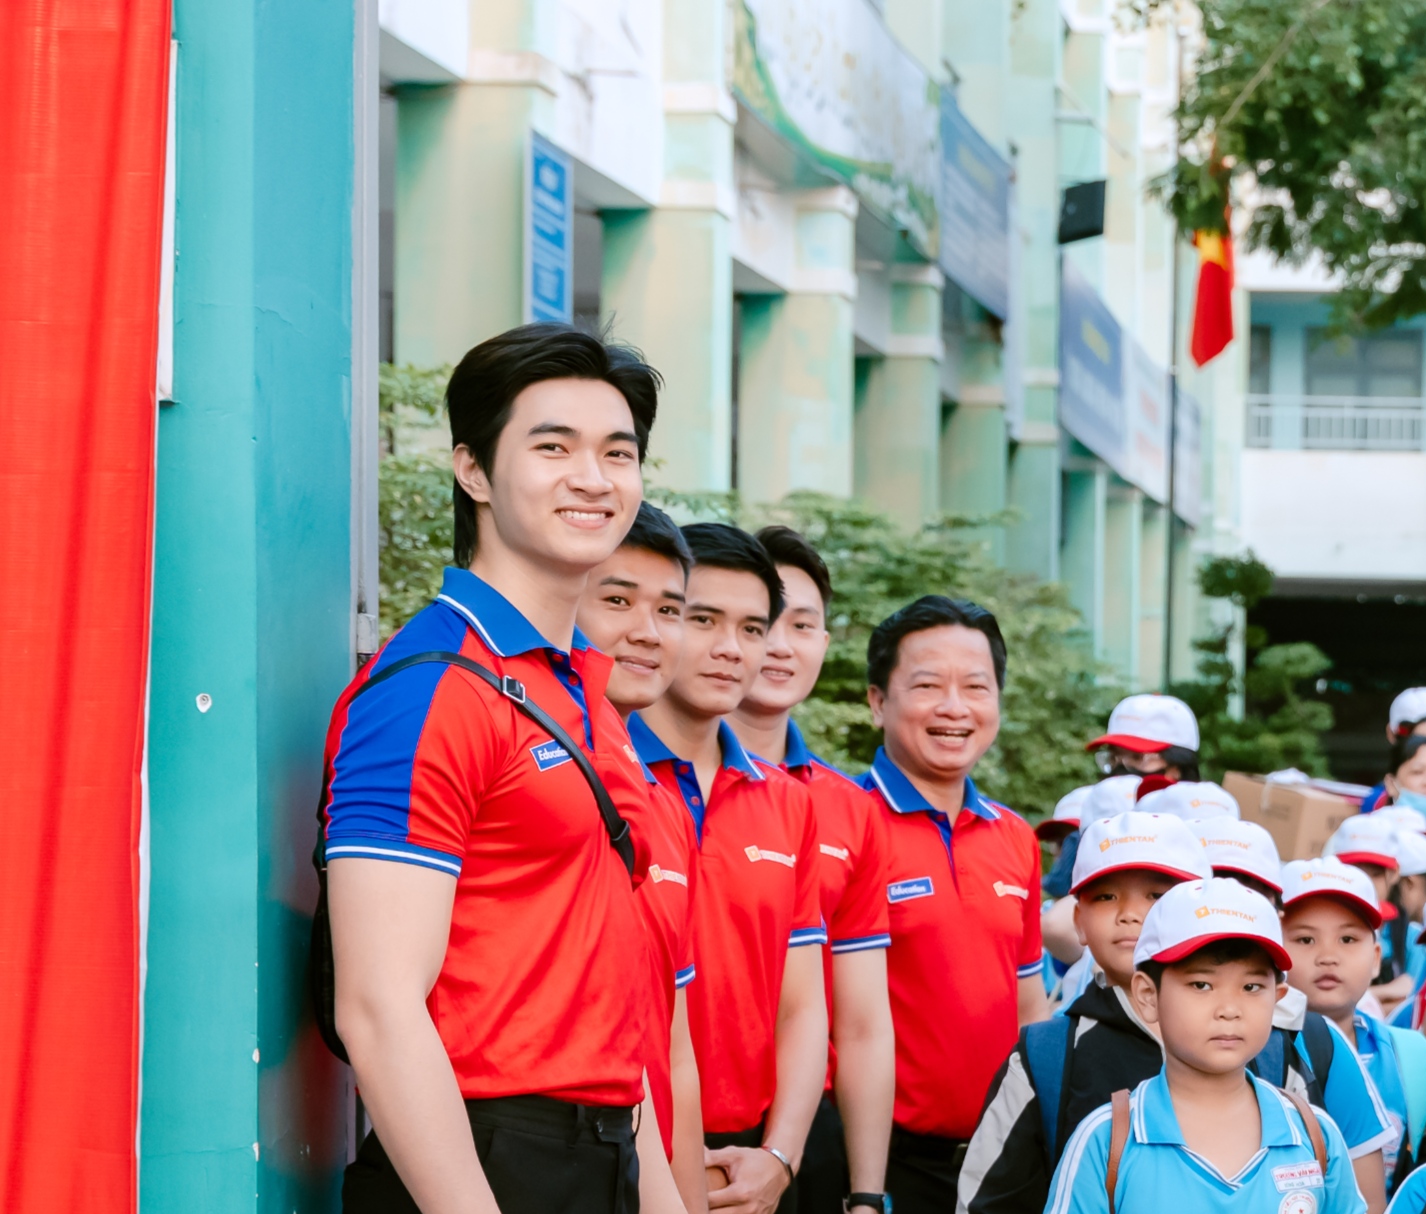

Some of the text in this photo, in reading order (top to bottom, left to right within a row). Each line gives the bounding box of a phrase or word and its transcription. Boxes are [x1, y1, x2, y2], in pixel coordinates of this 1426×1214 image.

[1110, 835, 1155, 846] THIENTAN
[1206, 837, 1250, 850] THIENTAN
[890, 884, 926, 896] Education
[1210, 907, 1255, 922] THIENTAN
